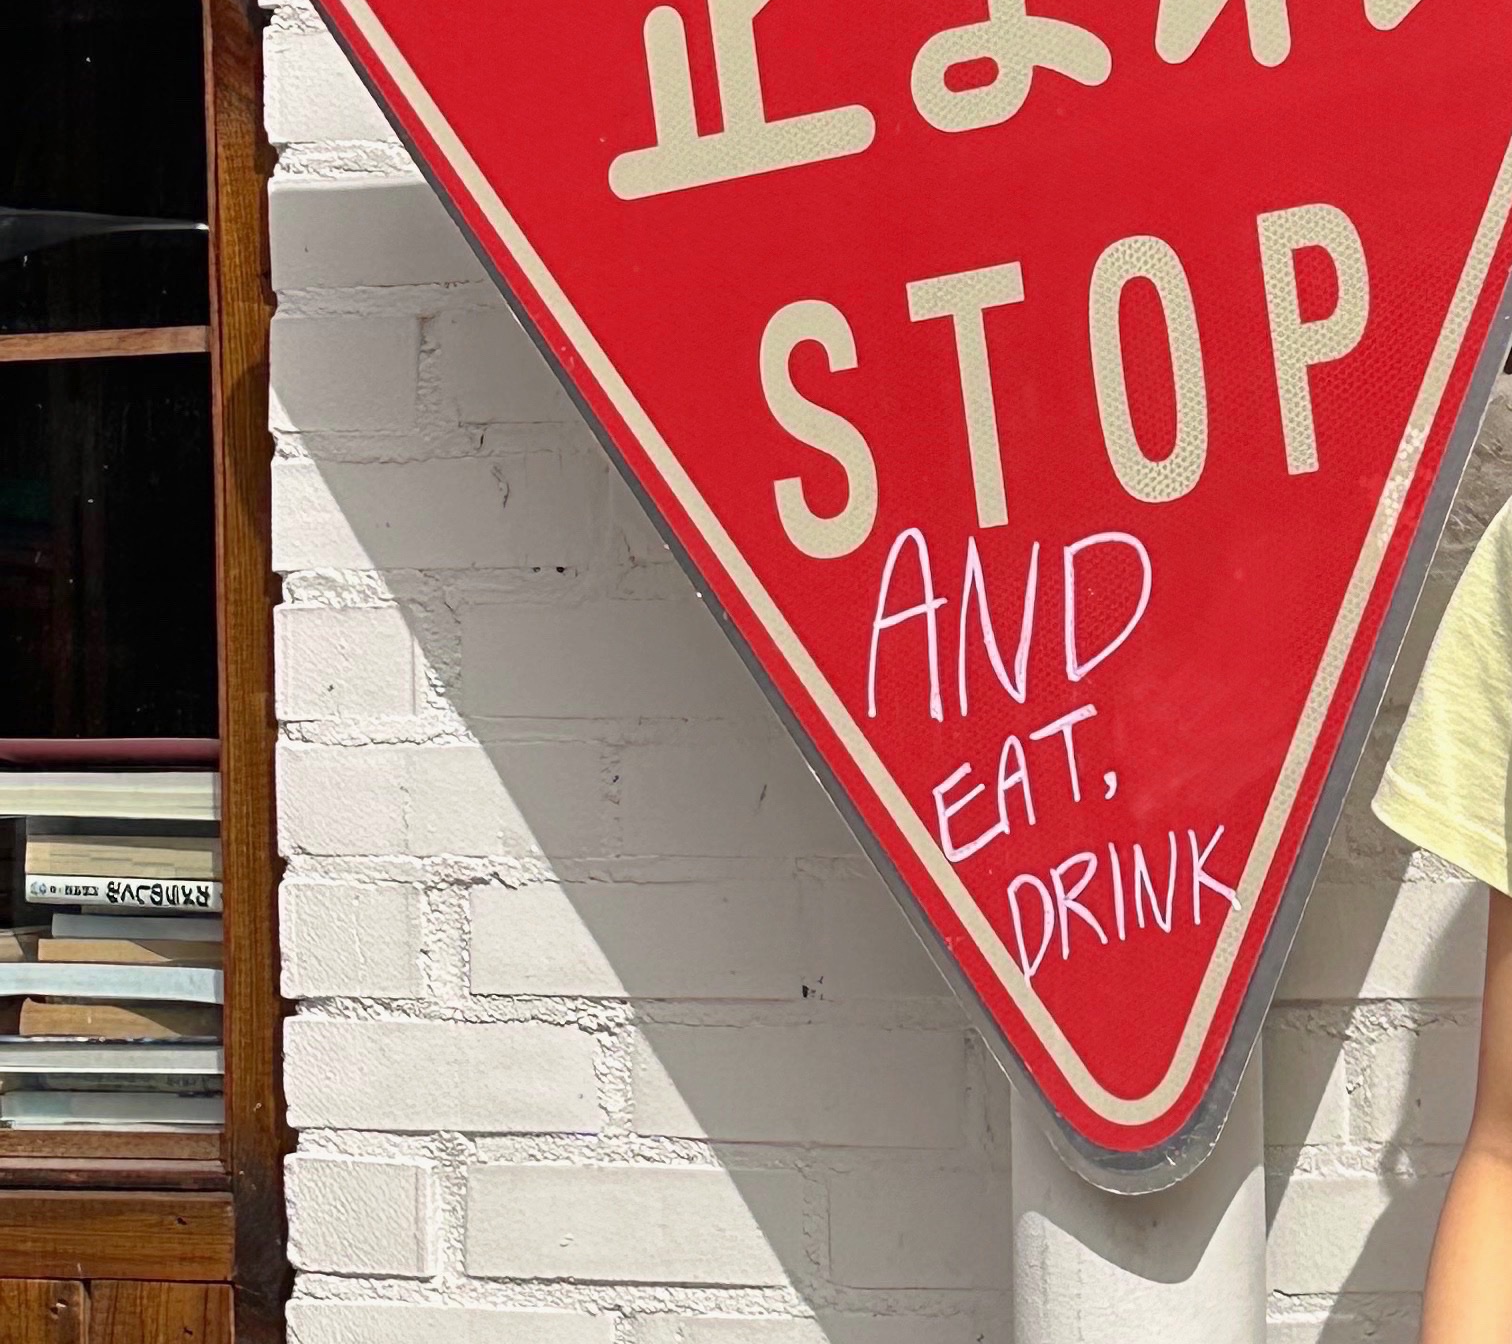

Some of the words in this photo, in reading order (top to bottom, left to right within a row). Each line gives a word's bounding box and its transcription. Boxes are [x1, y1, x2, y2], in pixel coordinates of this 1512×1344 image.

[759, 203, 1370, 560] STOP
[867, 527, 1153, 722] AND
[932, 704, 1118, 863] EAT,
[1006, 824, 1243, 988] DRINK
